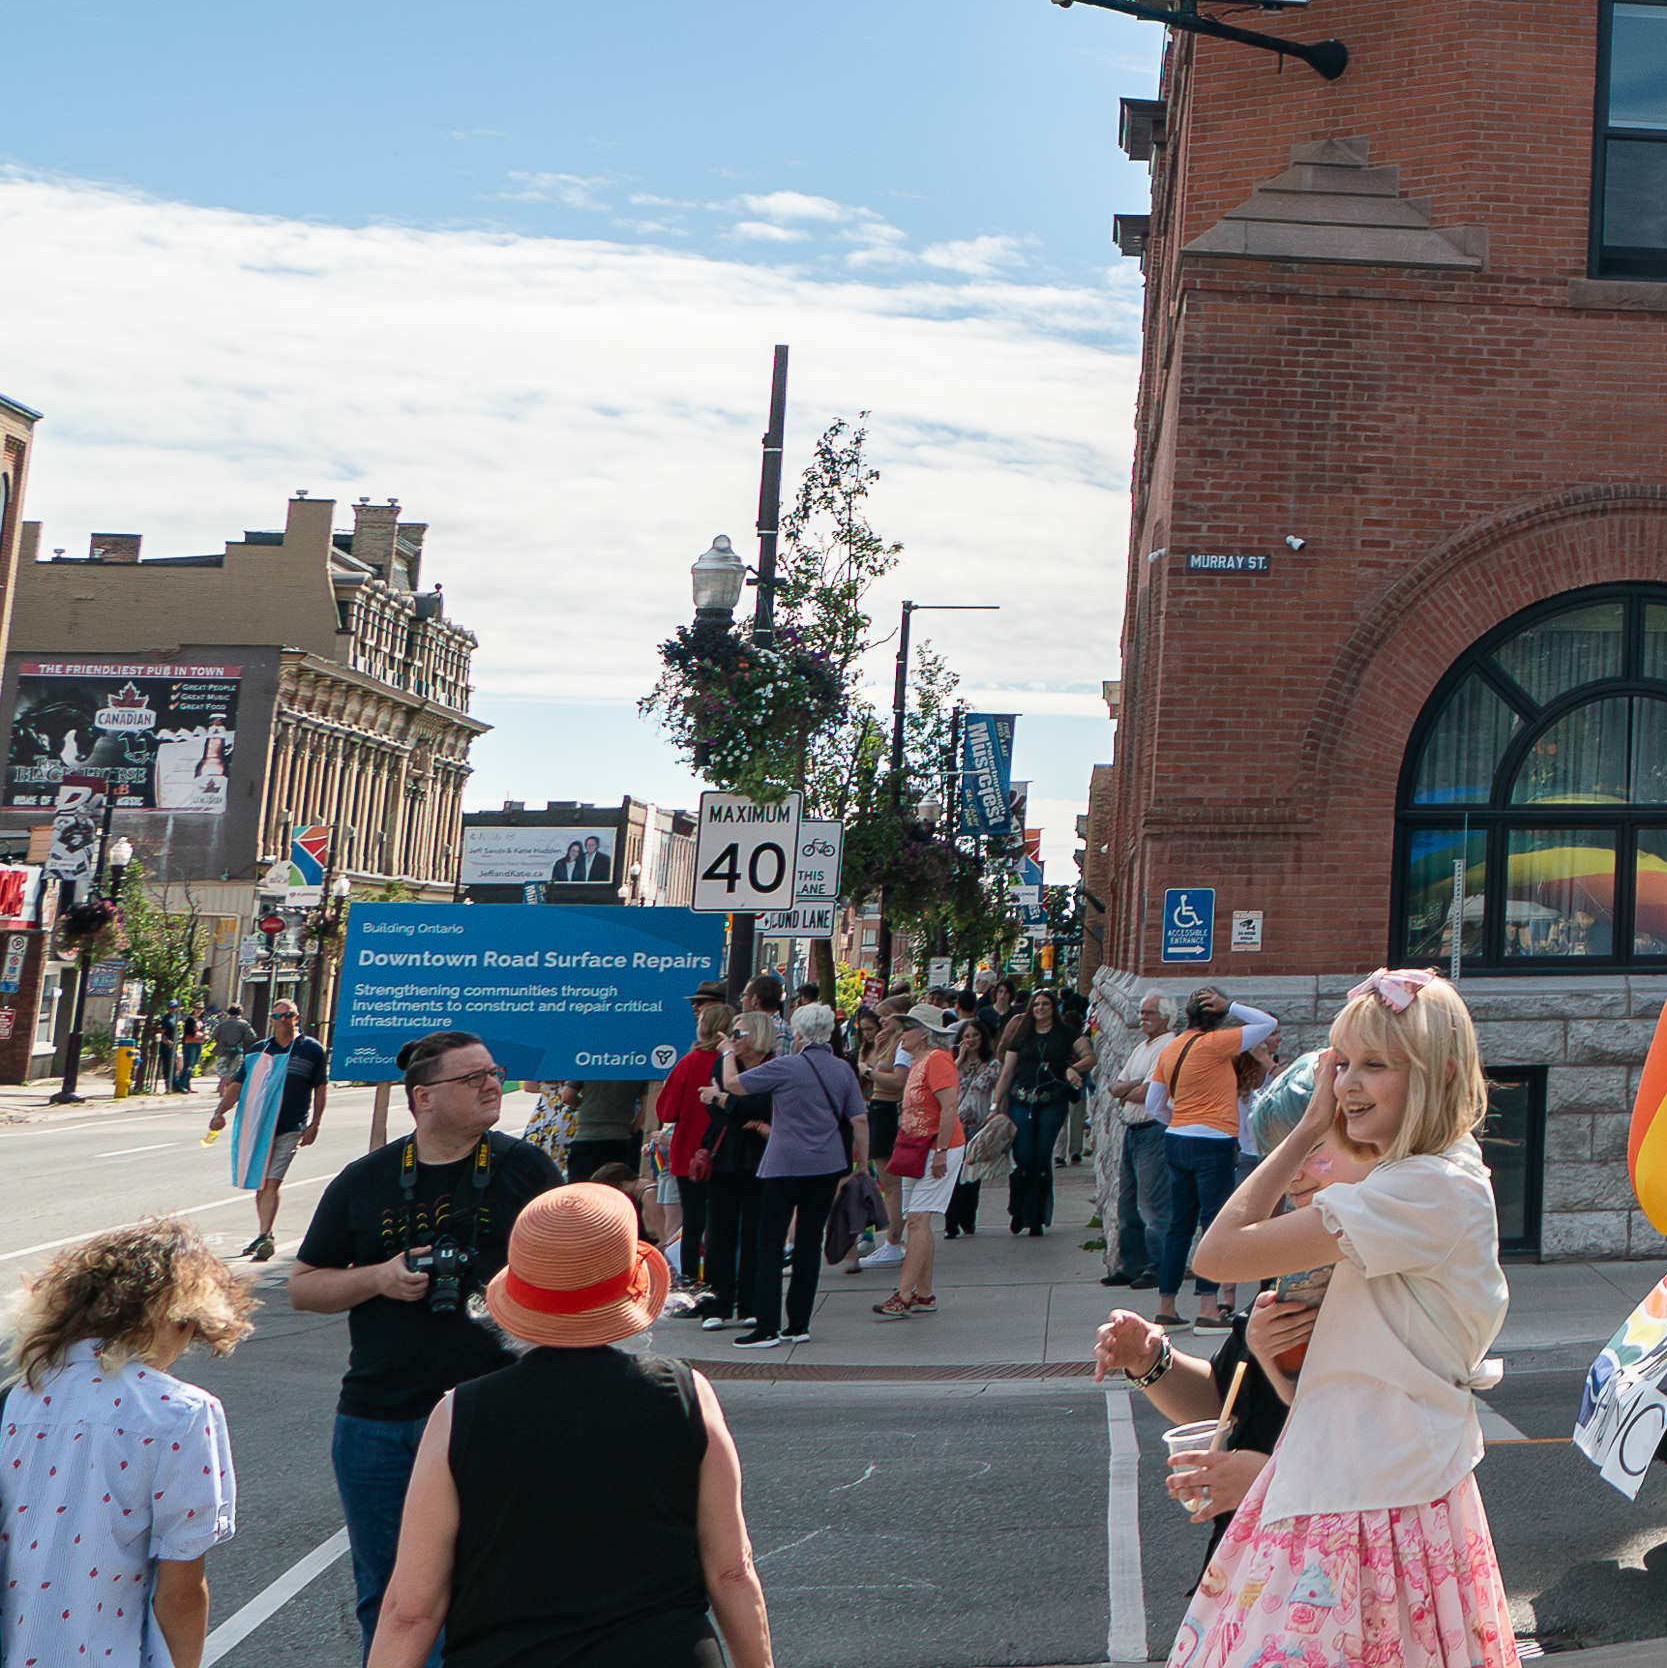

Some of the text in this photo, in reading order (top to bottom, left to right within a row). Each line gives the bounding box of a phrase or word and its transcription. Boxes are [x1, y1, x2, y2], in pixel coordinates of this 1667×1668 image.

[1190, 555, 1268, 570] MURRAY ST.
[39, 664, 225, 677] THE FRIENDLIEST PUB IN TOWN
[98, 713, 152, 725] CANADIAN
[967, 721, 1006, 826] Musicfest
[986, 740, 1006, 816] Peterborough
[709, 805, 791, 823] MAXIMUM
[701, 842, 787, 894] 40
[797, 870, 825, 881] THIS
[796, 883, 827, 895] ANE
[802, 909, 831, 929] LANE
[363, 922, 464, 936] Building Ontario
[1167, 929, 1208, 937] ACCESSIBLE
[1013, 937, 1029, 952] P
[1170, 937, 1206, 945] ENTRANCE
[358, 949, 711, 973] Downtown Road Surface Repairs
[355, 983, 618, 1000] Strengthening communities through
[353, 999, 663, 1015] investments to construct and repair critical
[350, 1014, 453, 1028] infrastructure
[344, 1053, 397, 1067] peterbor
[575, 1051, 647, 1067] Ontario
